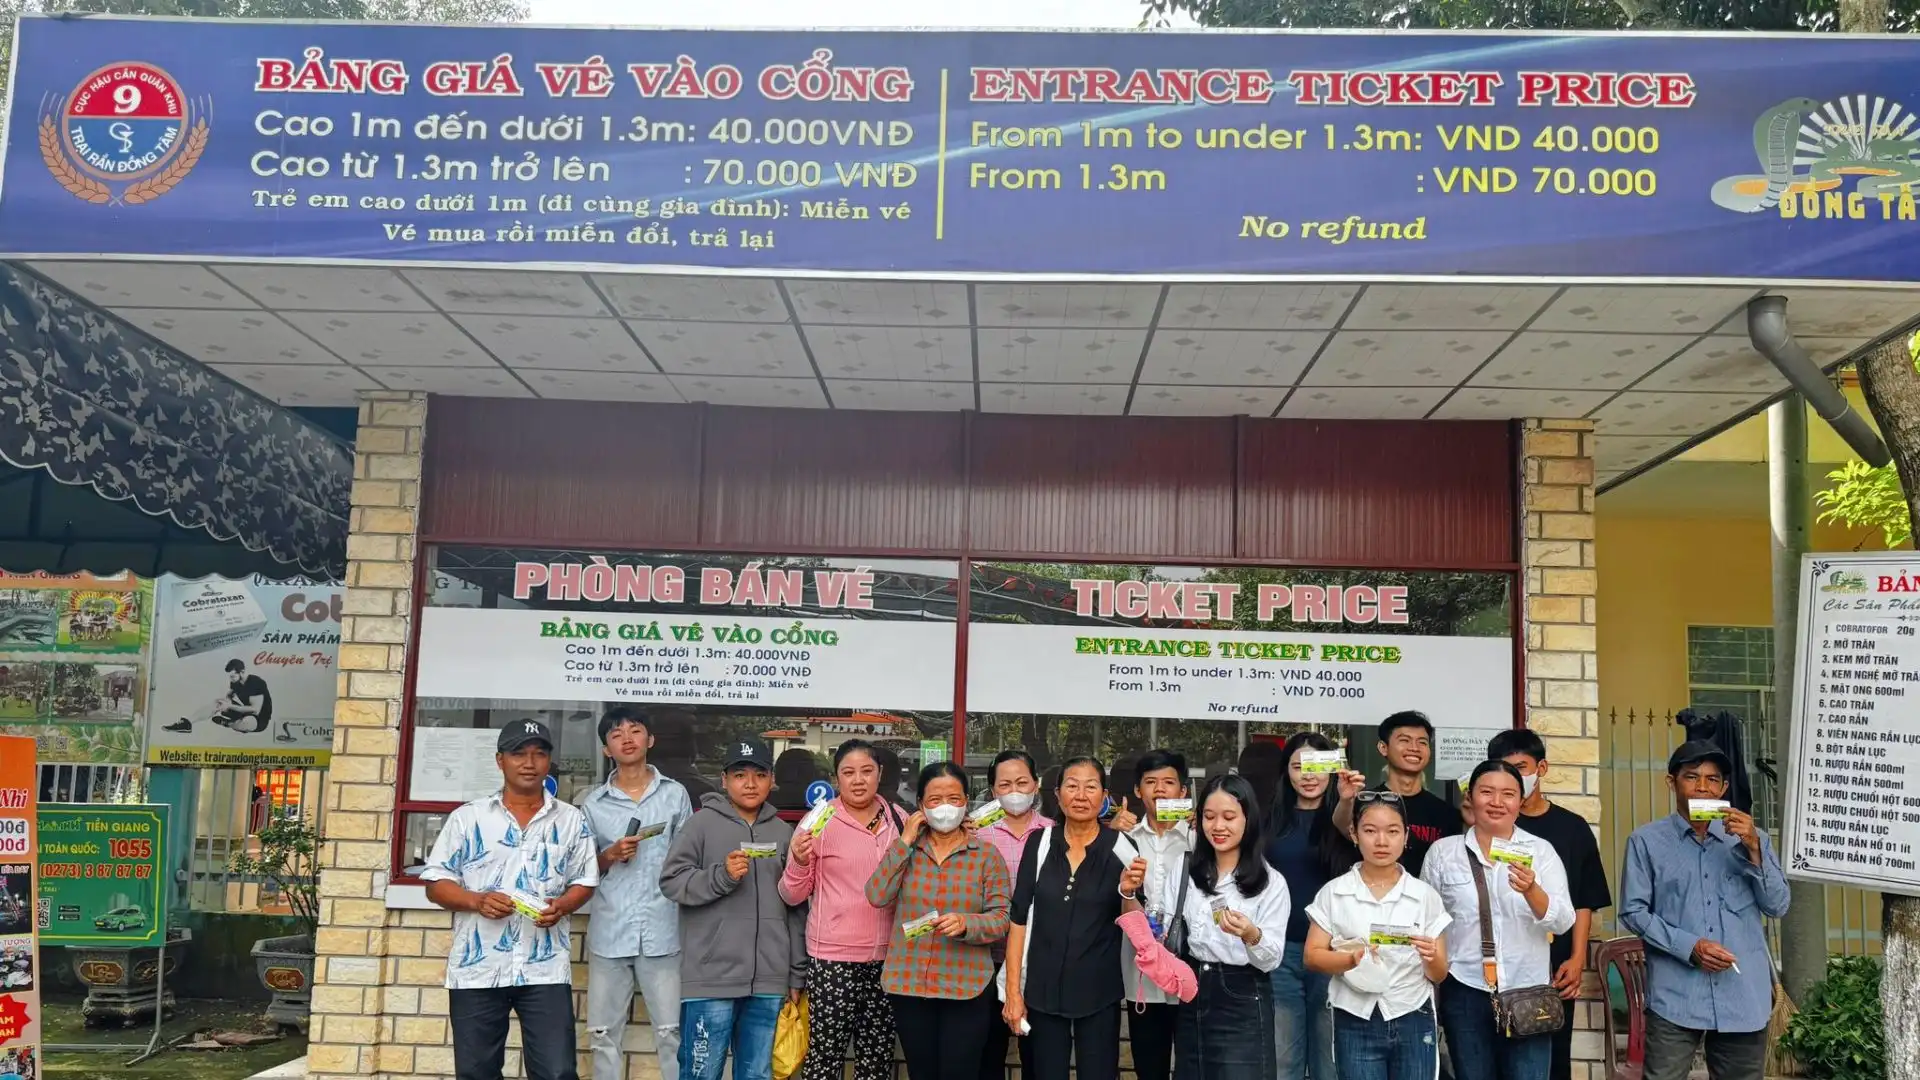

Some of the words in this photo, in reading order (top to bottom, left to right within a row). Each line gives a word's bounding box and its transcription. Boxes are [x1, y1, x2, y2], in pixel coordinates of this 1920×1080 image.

[255, 47, 409, 97] BẢNG
[423, 53, 524, 97] GIÁ
[536, 55, 614, 99] VÉ
[628, 56, 743, 100] VÀO
[759, 48, 914, 101] CỔNG
[74, 91, 91, 113] CỤC
[90, 75, 112, 92] HẬU
[164, 92, 177, 114] KHU
[970, 67, 1274, 105] ENTRANCE
[1287, 70, 1504, 107] TICKET
[1517, 71, 1696, 108] PRICE
[113, 85, 142, 113] 9
[255, 109, 334, 136] Cao
[351, 112, 401, 138] 1m
[414, 110, 487, 140] đến
[500, 114, 583, 141] dưới
[601, 116, 696, 142] 1.3m:
[708, 118, 913, 145] 40.000VNĐ
[971, 121, 1062, 148] From
[1080, 122, 1133, 148] 1m
[1146, 124, 1183, 149] to
[1195, 125, 1306, 150] under
[1322, 124, 1423, 151] 1.3m:
[1437, 125, 1520, 151] VND
[1533, 126, 1659, 154] 40.000
[71, 125, 92, 156] TRẠI
[251, 150, 330, 177] Cao
[342, 151, 379, 179] từ
[395, 154, 478, 180] 1.3m
[491, 151, 541, 181] trở
[553, 156, 610, 182] lên
[703, 159, 821, 187] 70.000
[834, 162, 917, 188] VNĐ
[970, 163, 1061, 190] From
[1078, 164, 1166, 191] 1.3m
[1433, 167, 1517, 193] VND
[1532, 167, 1656, 195] 70.000
[252, 188, 297, 207] Trẻ
[308, 194, 349, 208] em
[359, 195, 405, 210] cao
[416, 194, 475, 211] dưới
[488, 195, 528, 212] 1m
[538, 194, 572, 214] (đi
[583, 196, 650, 218] cùng
[660, 197, 700, 219] gia
[800, 198, 870, 219] Miễn
[879, 202, 912, 220] vé
[1879, 183, 1917, 220] TÂ
[383, 223, 417, 241] Vé
[428, 227, 486, 242] mua
[496, 221, 535, 242] rồi
[545, 221, 615, 243] miễn
[690, 228, 728, 246] trả
[740, 230, 775, 251] lại
[1239, 216, 1289, 239] No
[1301, 216, 1426, 243] refund
[513, 556, 686, 602] PHÒNG
[700, 563, 803, 607] BÁN
[815, 563, 875, 609] VÉ
[1071, 578, 1240, 621] TICKET
[1257, 584, 1409, 624] PRICE
[261, 629, 292, 643] SẢN
[540, 617, 611, 640] BẢNG
[712, 623, 763, 644] VÀO
[770, 620, 840, 646] CỔNG
[1835, 624, 1888, 634] COBRATOFOR
[1897, 626, 1915, 636] 20g
[565, 644, 596, 655] Cao
[602, 645, 621, 655] 1m
[626, 644, 653, 656] đến
[658, 646, 689, 657] dưới
[735, 649, 810, 661] 40.000VNĐ
[1075, 637, 1211, 658] ENTRANCE
[1217, 641, 1314, 661] TICKET
[1320, 645, 1402, 664] PRICE
[1823, 640, 1831, 648] 2.
[565, 660, 594, 671] Cao
[599, 660, 613, 671] từ
[619, 662, 650, 672] 1.3m
[655, 661, 673, 673] trở
[678, 663, 699, 673] lên
[733, 665, 777, 676] 70.000
[781, 666, 812, 677] VNĐ
[1822, 655, 1830, 664] 3.
[1832, 655, 1853, 664] KEM
[1109, 664, 1143, 675] From
[1150, 665, 1169, 676] 1m
[1174, 666, 1187, 676] to
[1192, 667, 1232, 678] under
[1238, 668, 1275, 679] 1.3m:
[1281, 670, 1311, 680] VND
[1316, 671, 1362, 682] 40.000
[1109, 680, 1143, 691] From
[1149, 681, 1181, 692] 1.3m
[1282, 686, 1314, 696] VND
[1319, 687, 1365, 698] 70.000
[1820, 684, 1828, 693] 5.
[1853, 685, 1872, 695] ONG
[1875, 687, 1905, 696] 600ml
[1208, 703, 1227, 713] No
[1231, 704, 1278, 715] refund
[1819, 699, 1826, 708] 6.
[1830, 699, 1848, 709] CAO
[1818, 714, 1826, 723] 7.
[1828, 714, 1846, 724] CAO
[160, 750, 201, 762] Website:
[204, 751, 315, 765] trairandongtam.com.vn
[1810, 758, 1823, 768] 10.
[1875, 764, 1905, 774] 600ml
[813, 786, 826, 803] 2
[112, 822, 150, 832] GIANG
[108, 838, 152, 859] 1055
[40, 863, 82, 879] (0273)
[85, 863, 94, 878] 3
[96, 863, 113, 879] 87
[115, 864, 132, 879] 87
[135, 864, 152, 879] 87
